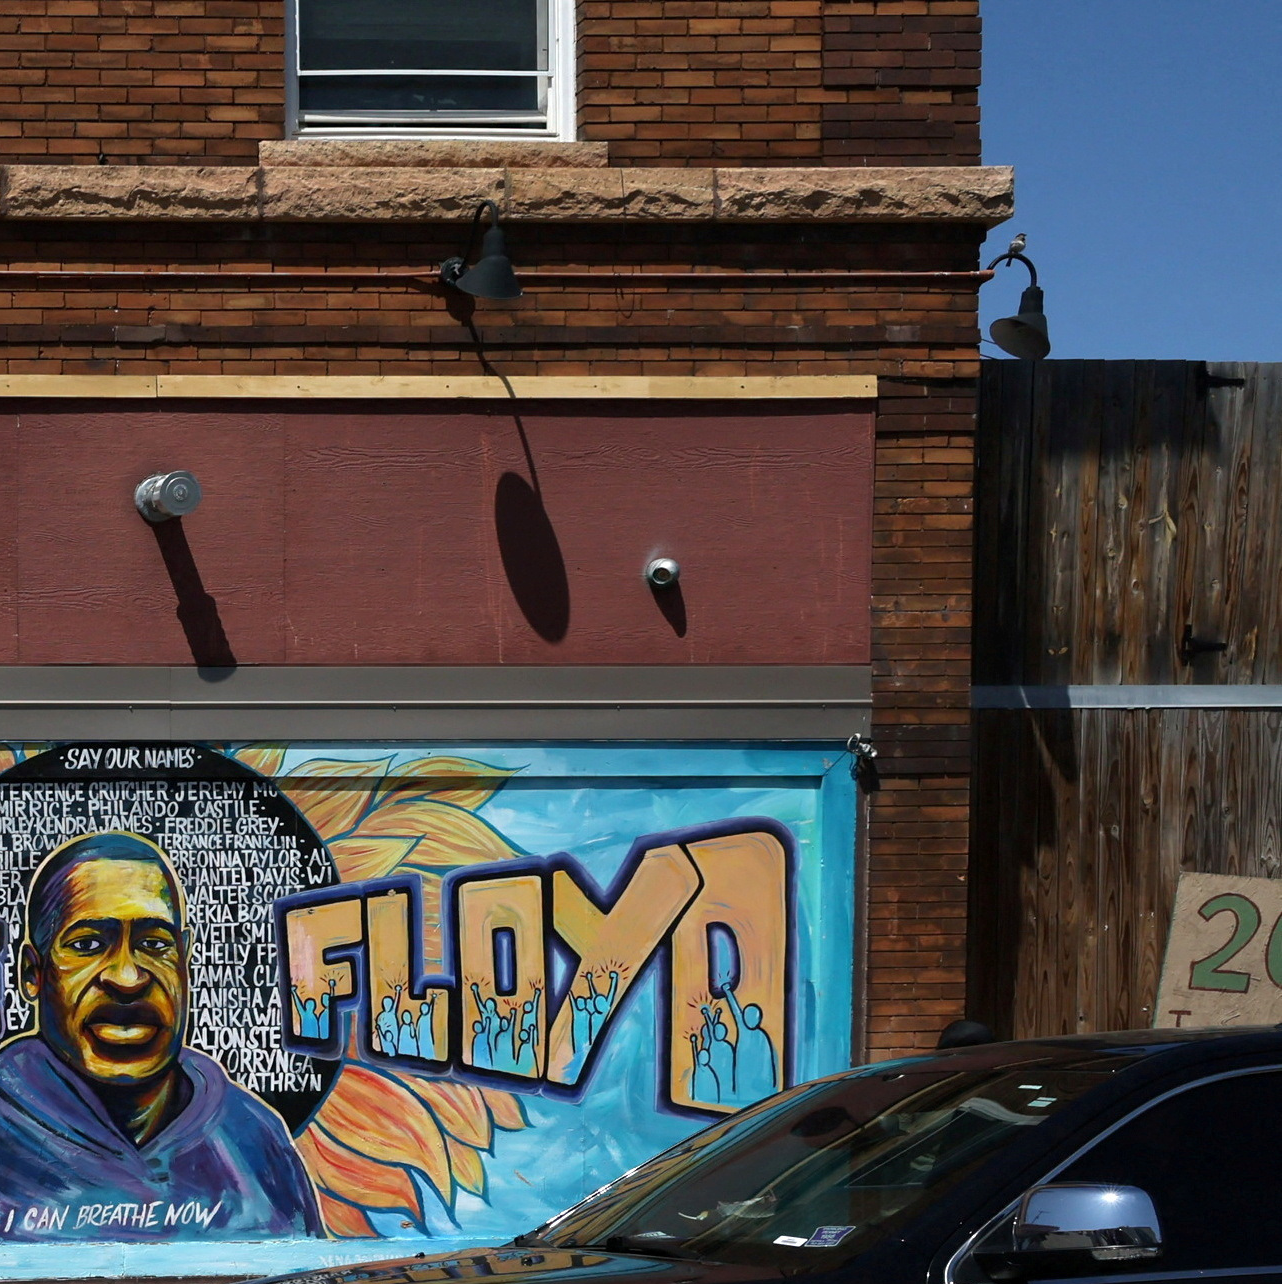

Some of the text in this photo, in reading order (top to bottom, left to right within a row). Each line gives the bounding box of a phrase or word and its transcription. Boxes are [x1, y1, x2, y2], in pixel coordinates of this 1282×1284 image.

[64, 747, 196, 770] SAY OUR NAMES
[88, 781, 169, 801] CRUTCHER
[175, 781, 246, 802] JEREMY
[30, 801, 72, 818] RICE
[88, 801, 179, 817] PHILANDO
[194, 801, 260, 818] CASTILE
[37, 816, 98, 835] KENDRA
[98, 815, 153, 835] JAMES
[165, 817, 232, 835] FREDDIE
[235, 817, 279, 837] GREY
[155, 834, 297, 850] TERRANCE FRANKLIN
[169, 848, 331, 868] BREONNA TAYLOR AL
[178, 866, 332, 887] SHANTEL DAVIS WI
[185, 886, 250, 905] WALTER
[186, 904, 234, 923] REKIA
[191, 943, 250, 965] SHELLY
[1189, 893, 1282, 994] 2
[189, 965, 247, 988] JAMAR
[282, 828, 791, 1116] FLOYD
[190, 987, 265, 1009] TANISHA
[190, 1008, 253, 1028] TARIKA
[190, 1027, 249, 1049] ALTON
[236, 1072, 323, 1093] KATHRYN
[4, 1199, 224, 1233] I CAN BREATHE NOW
